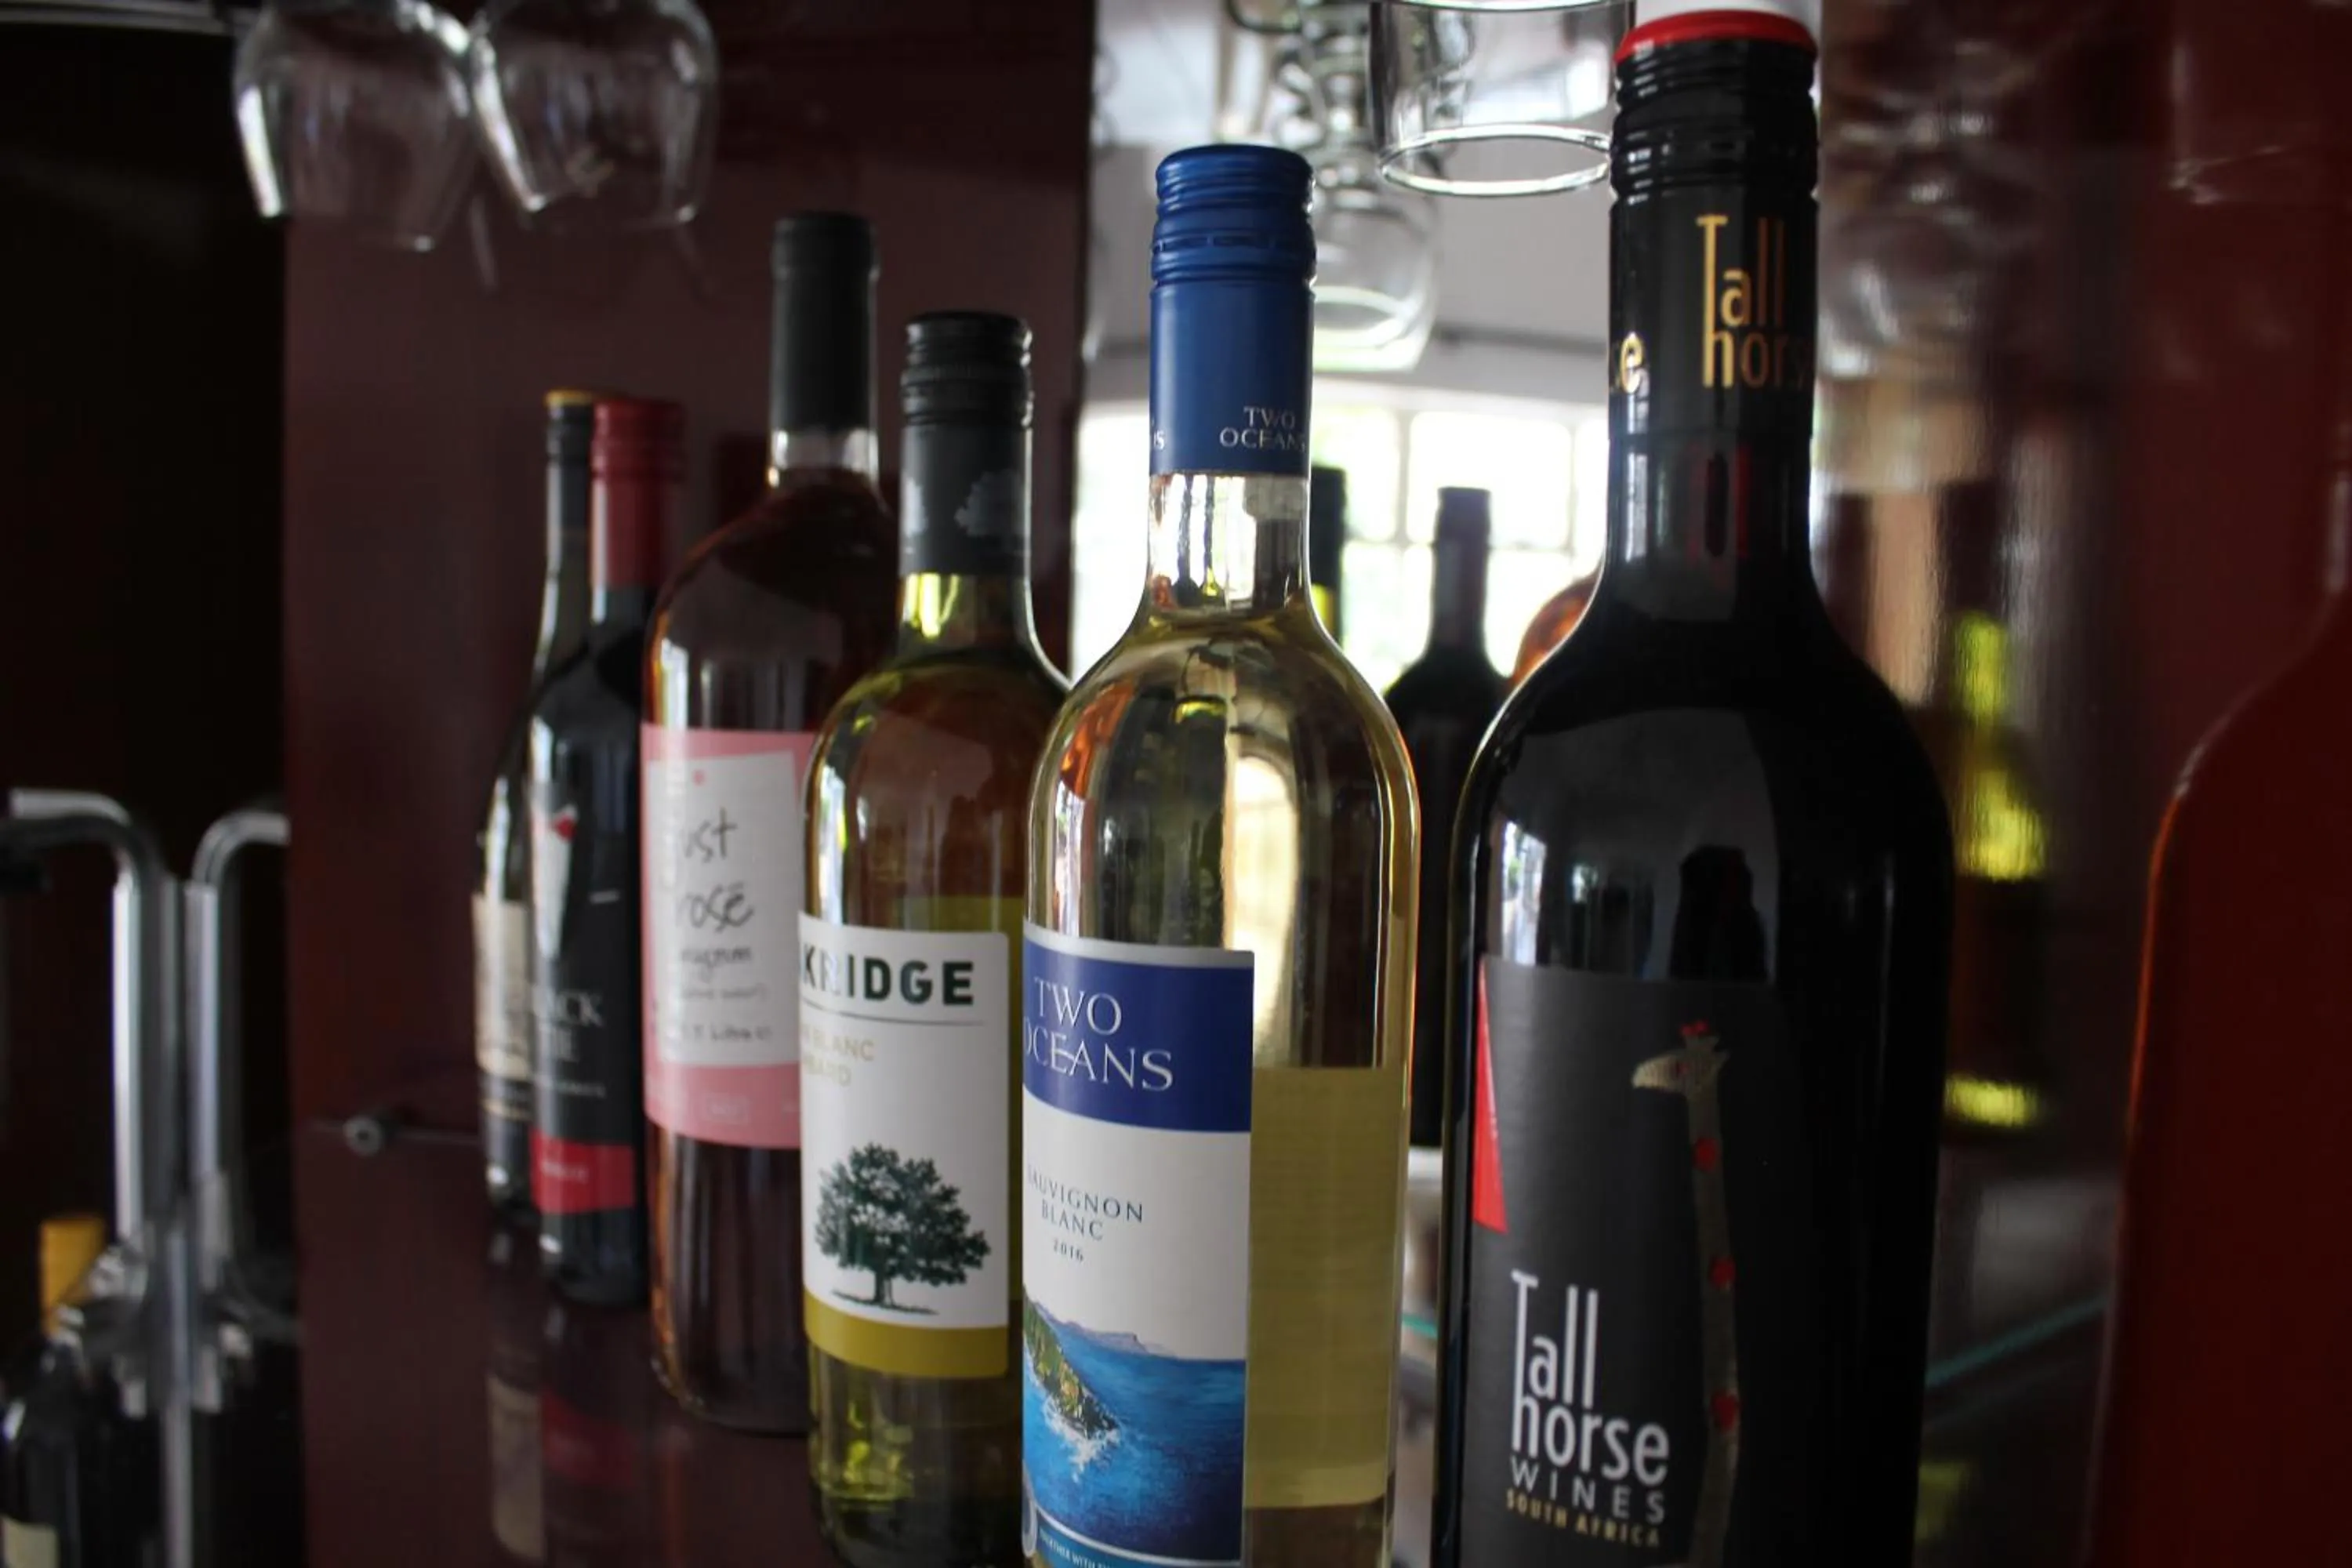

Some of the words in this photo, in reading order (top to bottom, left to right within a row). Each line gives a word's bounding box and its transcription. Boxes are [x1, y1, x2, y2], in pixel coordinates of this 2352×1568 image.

[1696, 214, 1784, 331] Tall
[1243, 405, 1297, 430] TWO
[1034, 976, 1123, 1036] TWO
[1041, 1198, 1105, 1242] BLANC
[1052, 1238, 1085, 1263] 2016
[1510, 1268, 1599, 1410] Tall
[1511, 1392, 1670, 1488] horse
[1505, 1487, 1568, 1529] SOUTH
[1575, 1514, 1661, 1548] AFRICA
[1510, 1454, 1666, 1526] WINES
